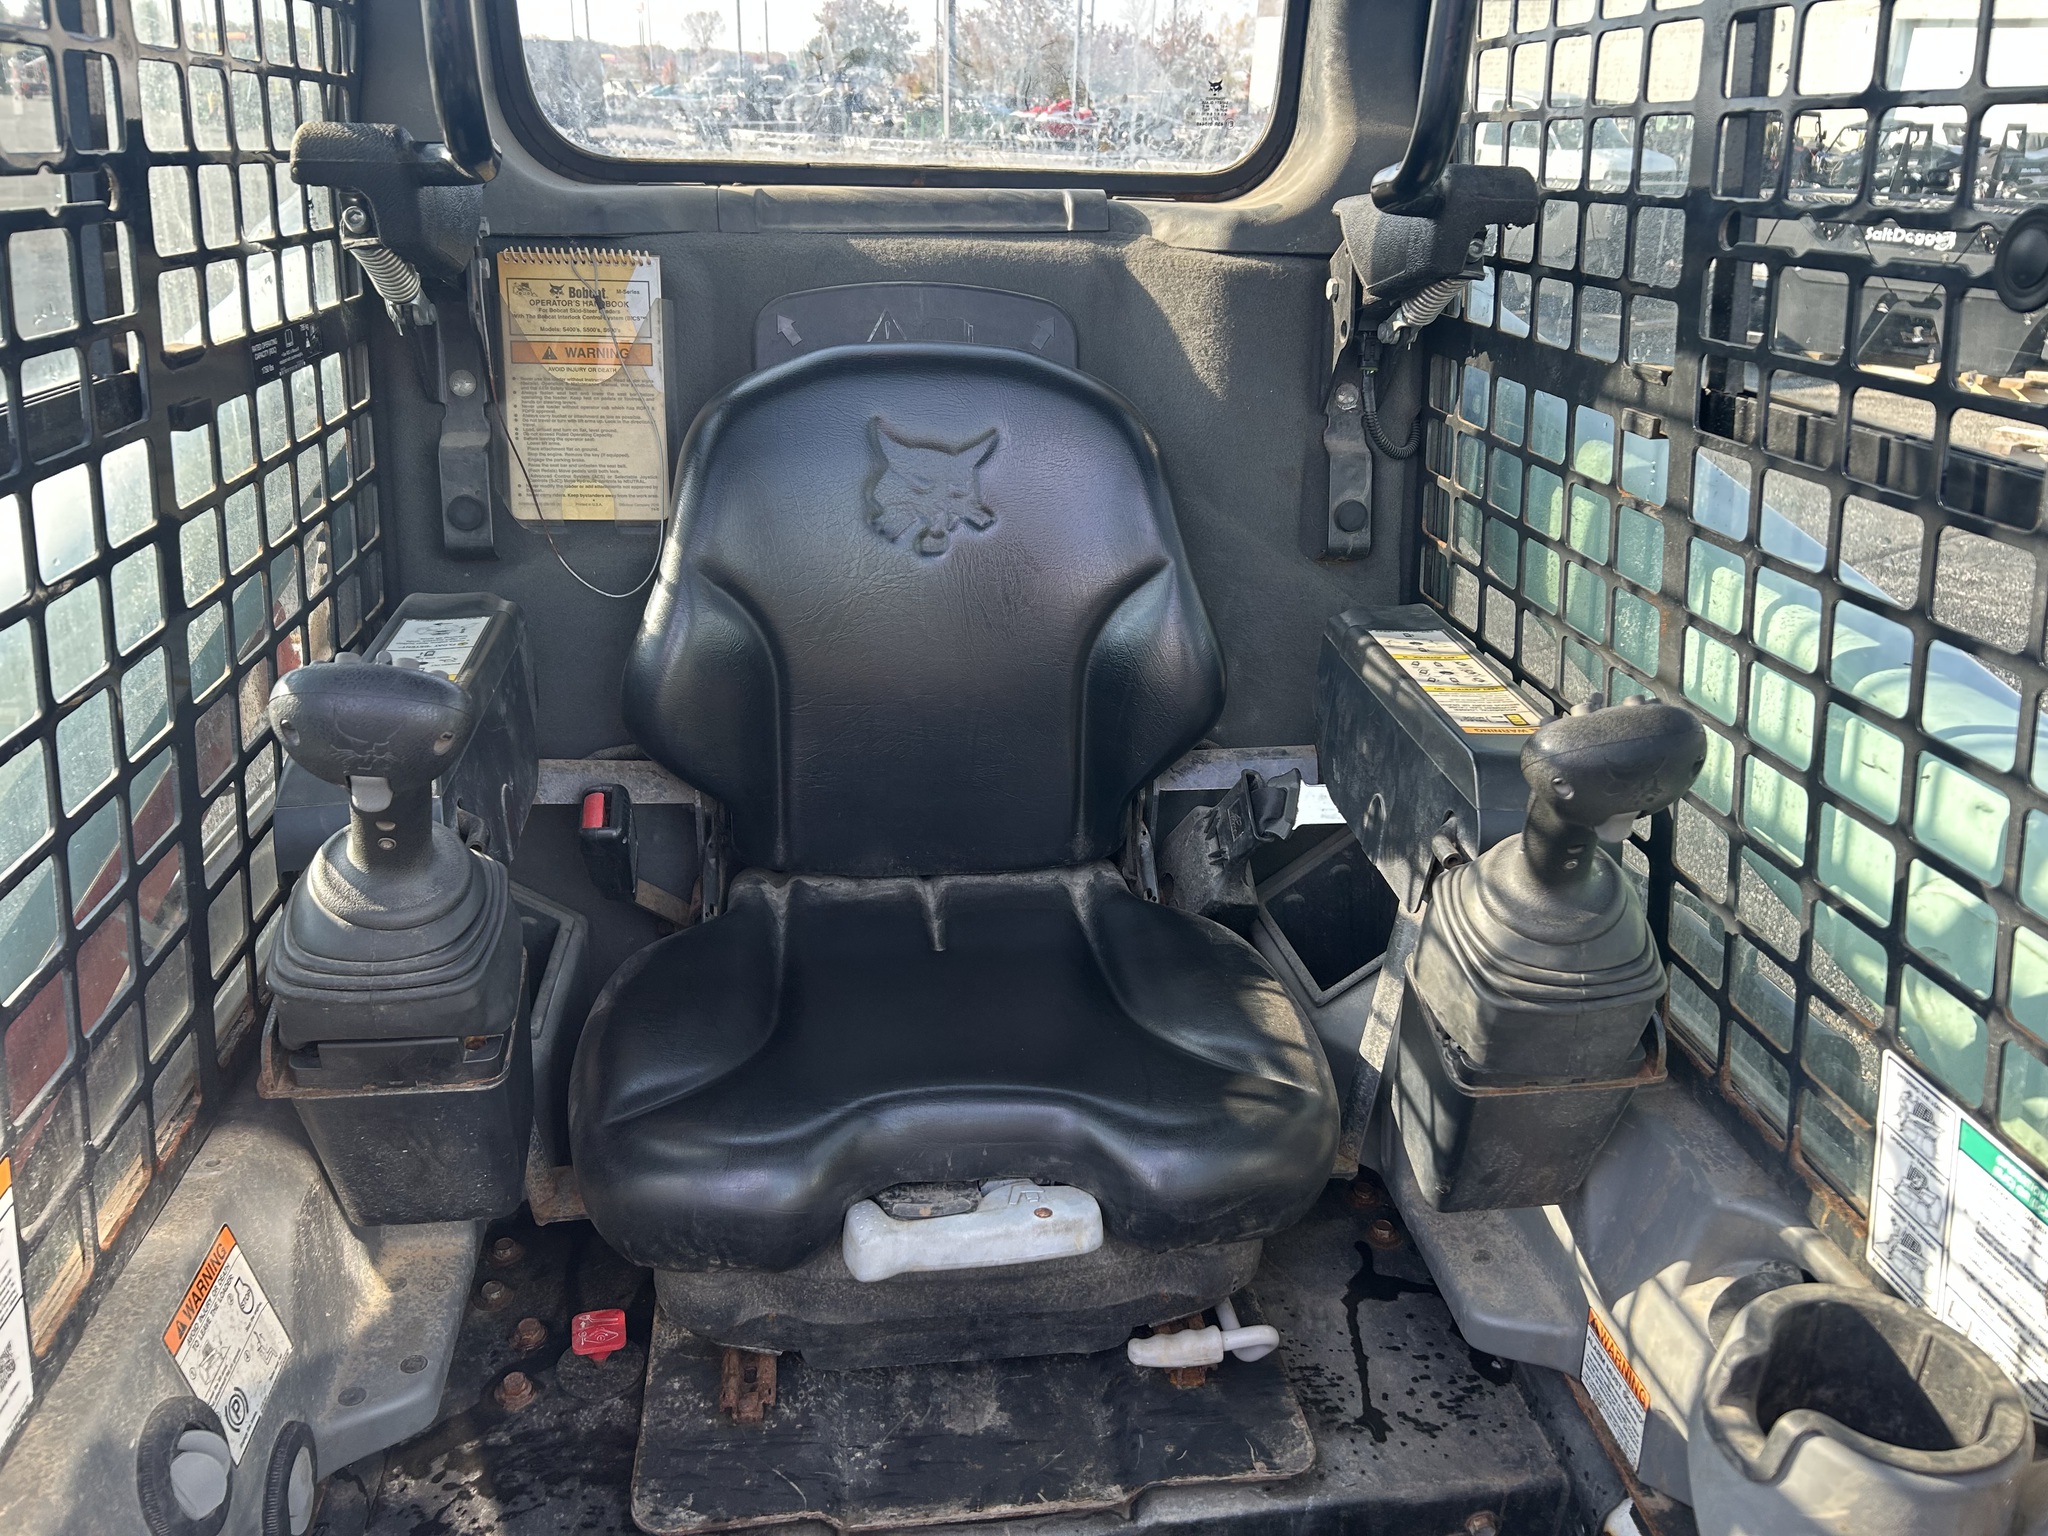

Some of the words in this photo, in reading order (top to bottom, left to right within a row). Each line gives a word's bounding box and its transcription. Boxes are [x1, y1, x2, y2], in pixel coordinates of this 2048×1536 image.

[565, 347, 629, 359] WARNING
[182, 1242, 226, 1323] WARNING
[240, 1287, 252, 1311] STOP
[186, 1321, 200, 1346] AVOID
[198, 1296, 213, 1324] INJURY
[212, 1285, 219, 1298] OR
[217, 1263, 231, 1288] DEATH
[192, 1338, 200, 1353] TO
[198, 1316, 212, 1342] LEAVE
[210, 1301, 220, 1319] THE
[1586, 1335, 1606, 1365] ALARM
[1600, 1327, 1648, 1406] WARNING
[232, 1399, 241, 1418] P
